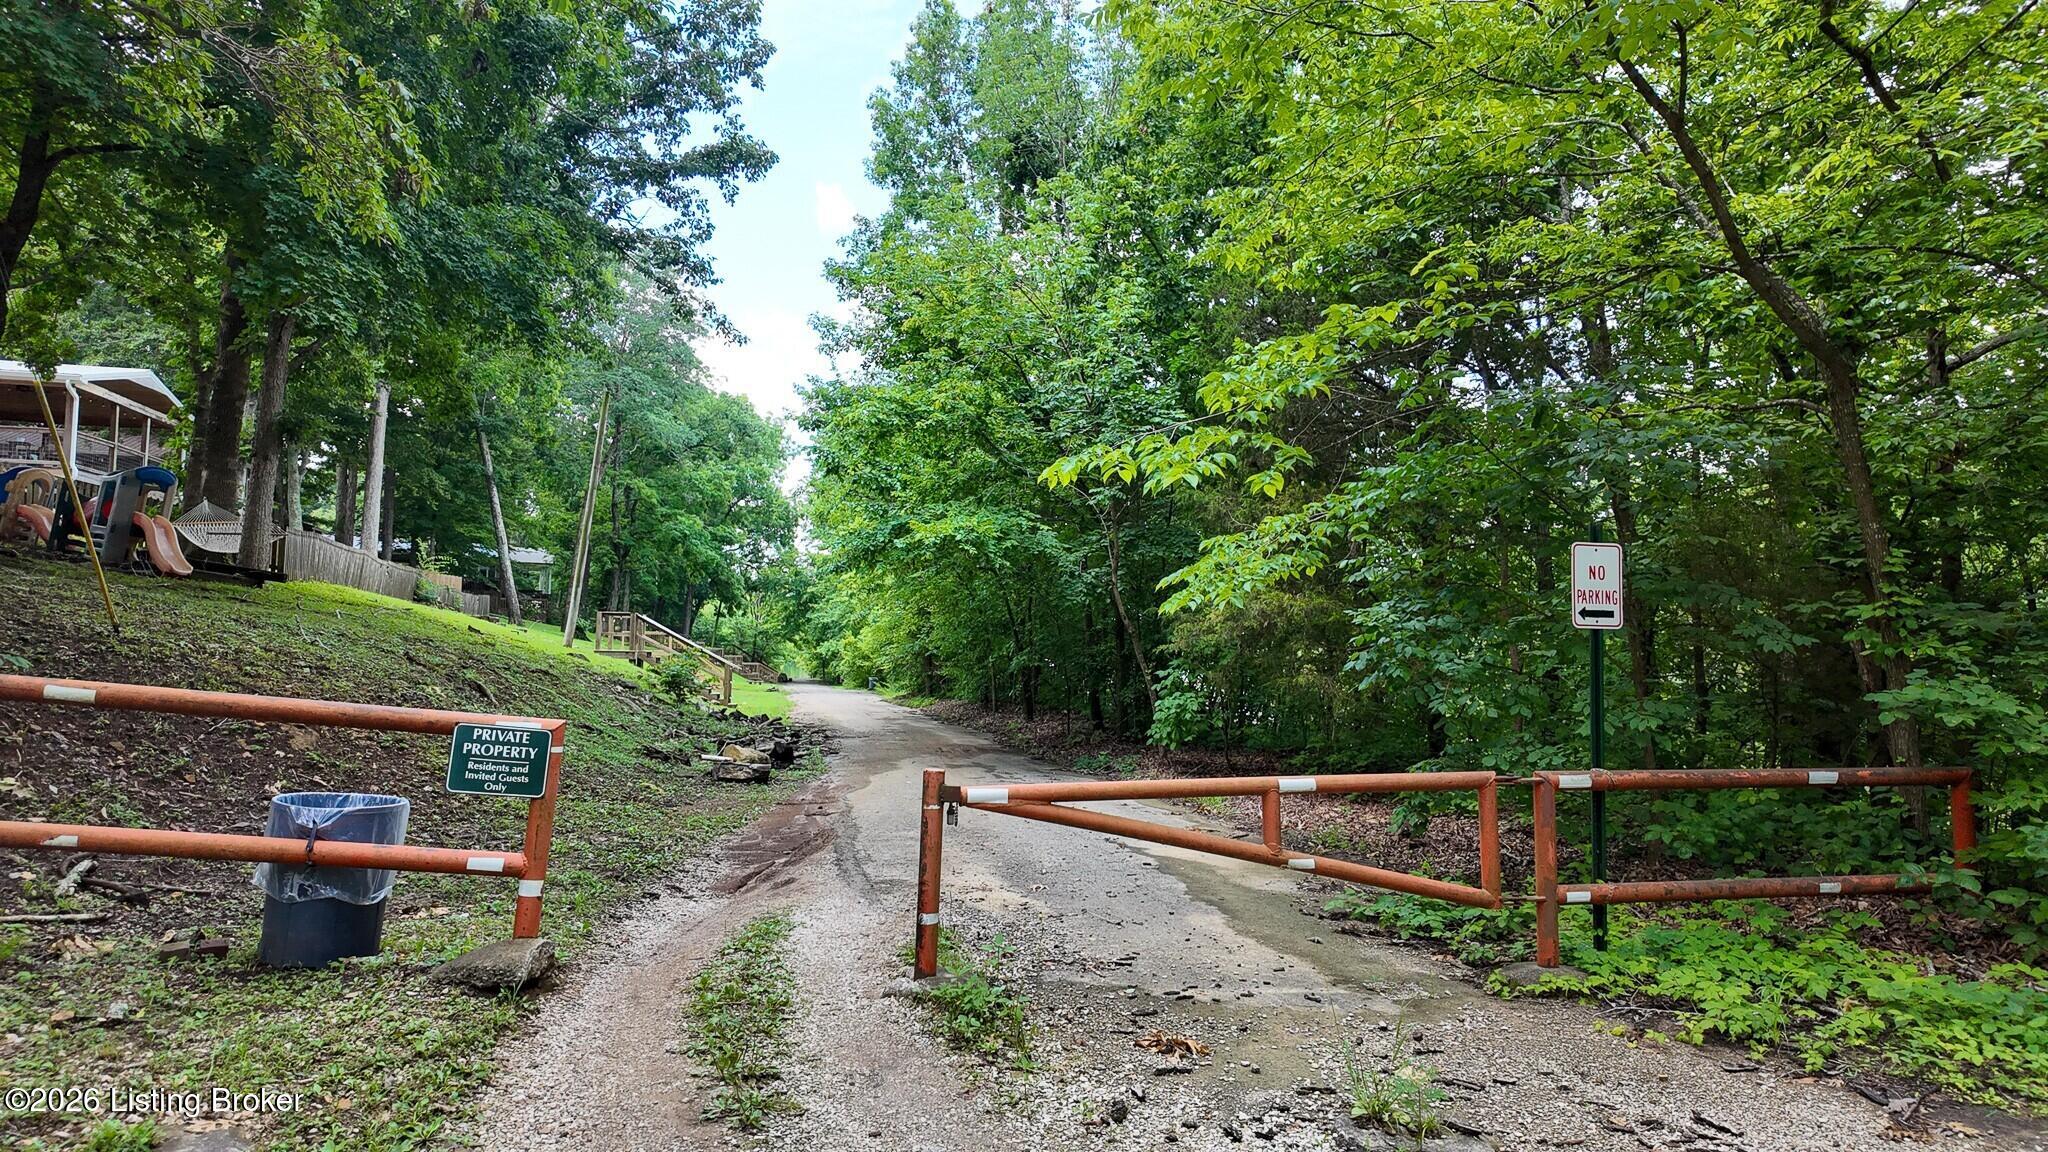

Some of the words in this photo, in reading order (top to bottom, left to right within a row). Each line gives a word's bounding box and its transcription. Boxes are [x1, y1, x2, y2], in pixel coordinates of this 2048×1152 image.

[1589, 565, 1605, 580] NO
[1577, 589, 1618, 605] PARKING
[473, 728, 531, 744] PRIVATE
[462, 742, 538, 759] PROPERTY
[467, 761, 509, 772] Residents
[511, 765, 529, 773] and
[465, 771, 496, 781] Invited
[498, 773, 529, 783] Guests
[484, 782, 507, 793] Only
